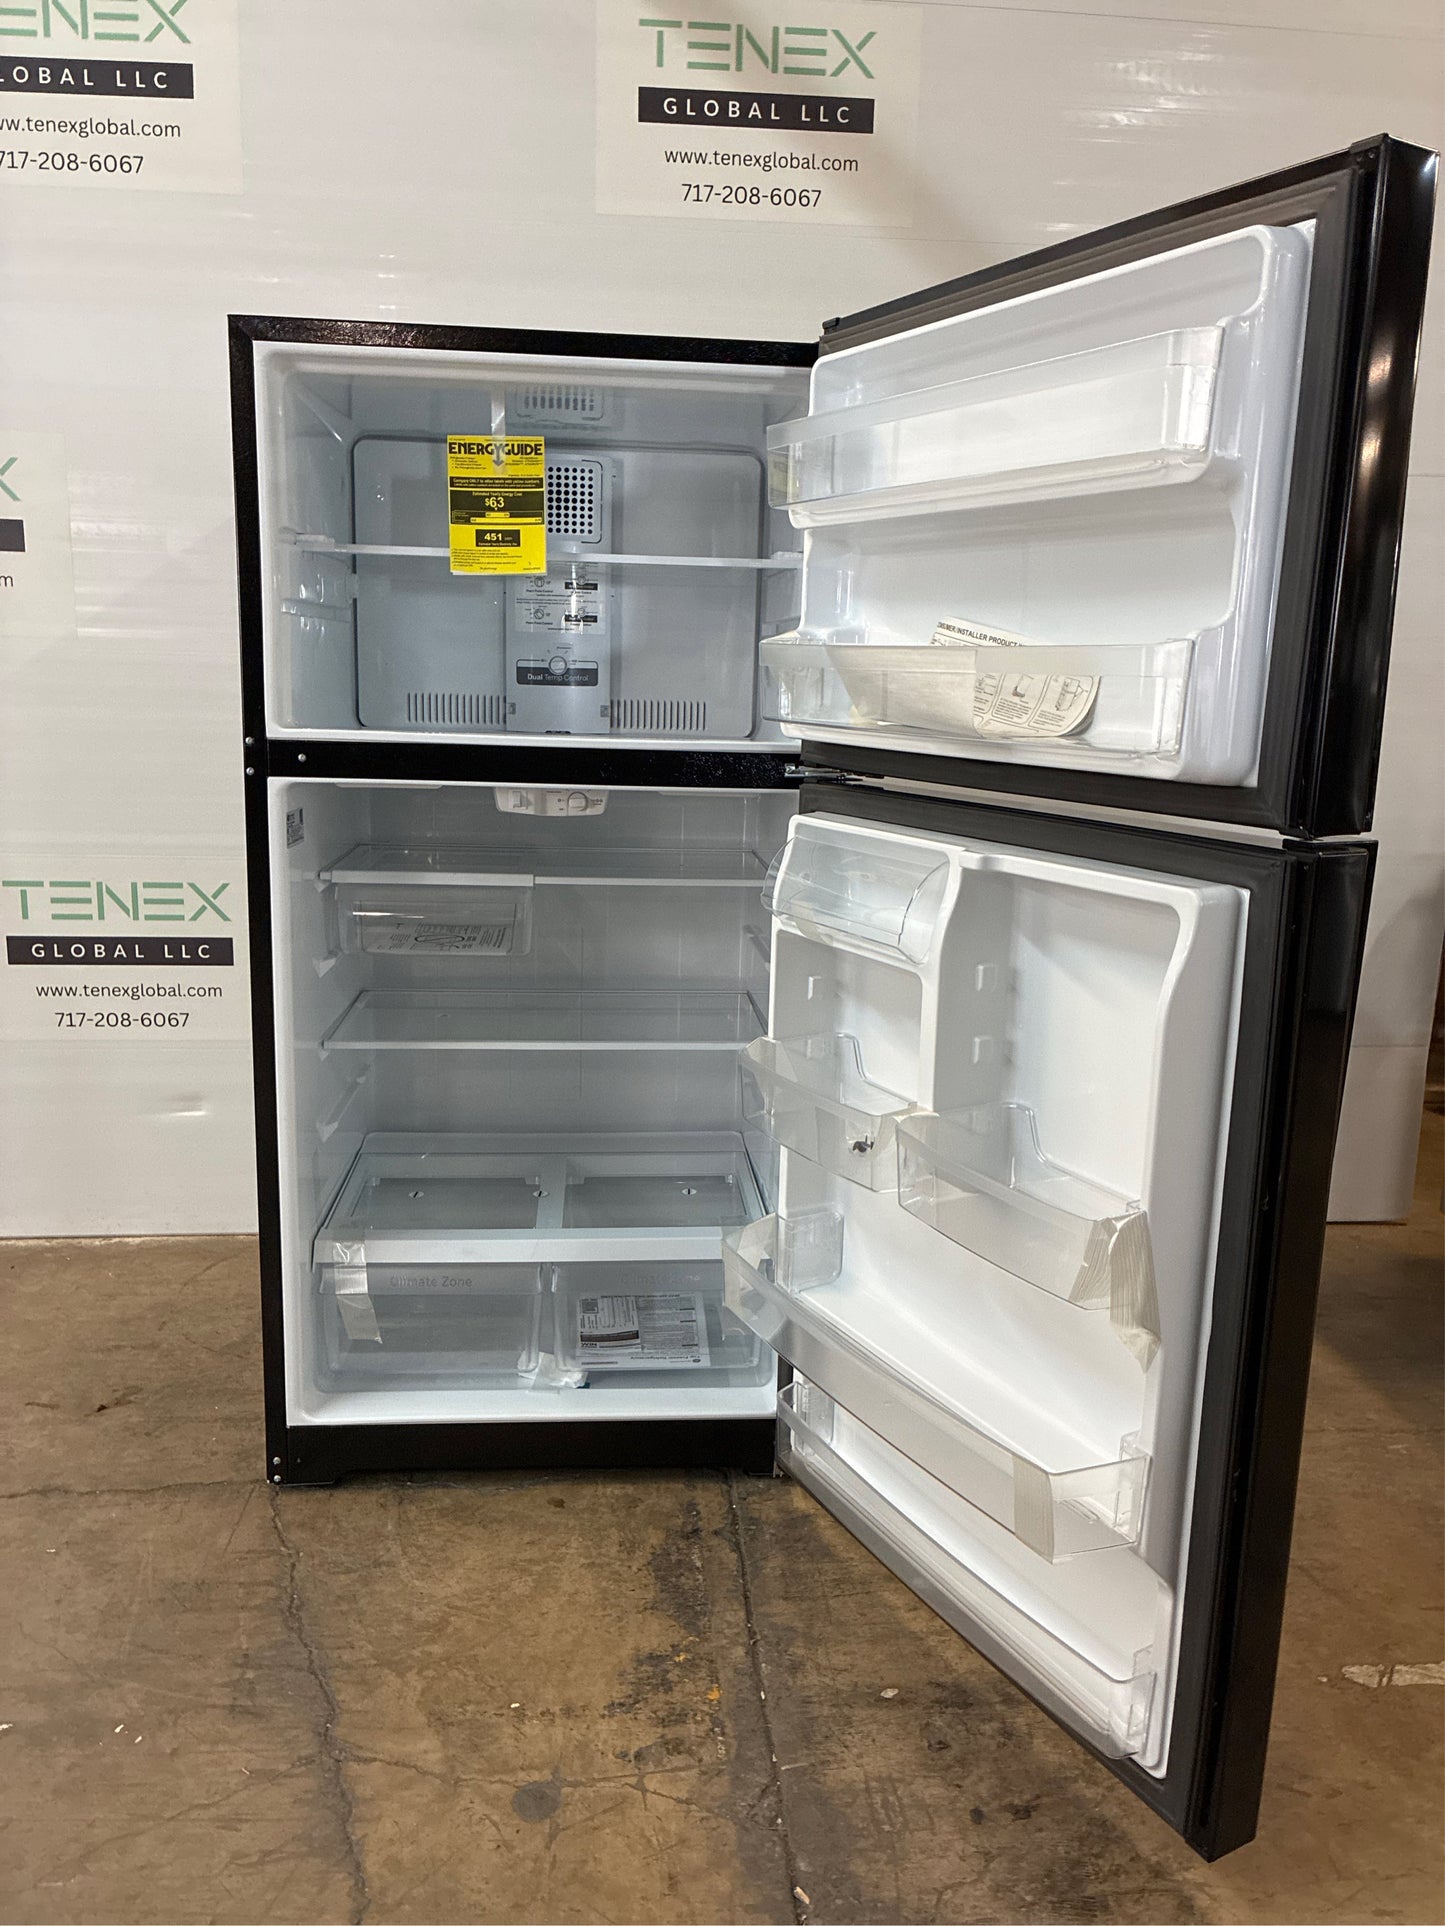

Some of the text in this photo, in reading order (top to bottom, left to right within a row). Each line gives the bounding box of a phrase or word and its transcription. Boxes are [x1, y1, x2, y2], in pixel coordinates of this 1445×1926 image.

[639, 18, 877, 79] TENEX
[0, 65, 168, 89] OBAL LLC
[663, 97, 850, 123] GLOBAL LLC
[664, 150, 859, 172] www.tenexglobal.com
[681, 184, 823, 207] 717-208-6067
[484, 497, 505, 508] $63
[484, 532, 502, 541] 451
[544, 673, 563, 682] Temp
[564, 673, 589, 681] Control
[2, 880, 232, 921] TENEX
[31, 943, 211, 959] GLOBAL LLC
[36, 983, 223, 1000] www.tenexglobal.com
[54, 1012, 190, 1027] 717-208-6067
[442, 1275, 473, 1288] Zone
